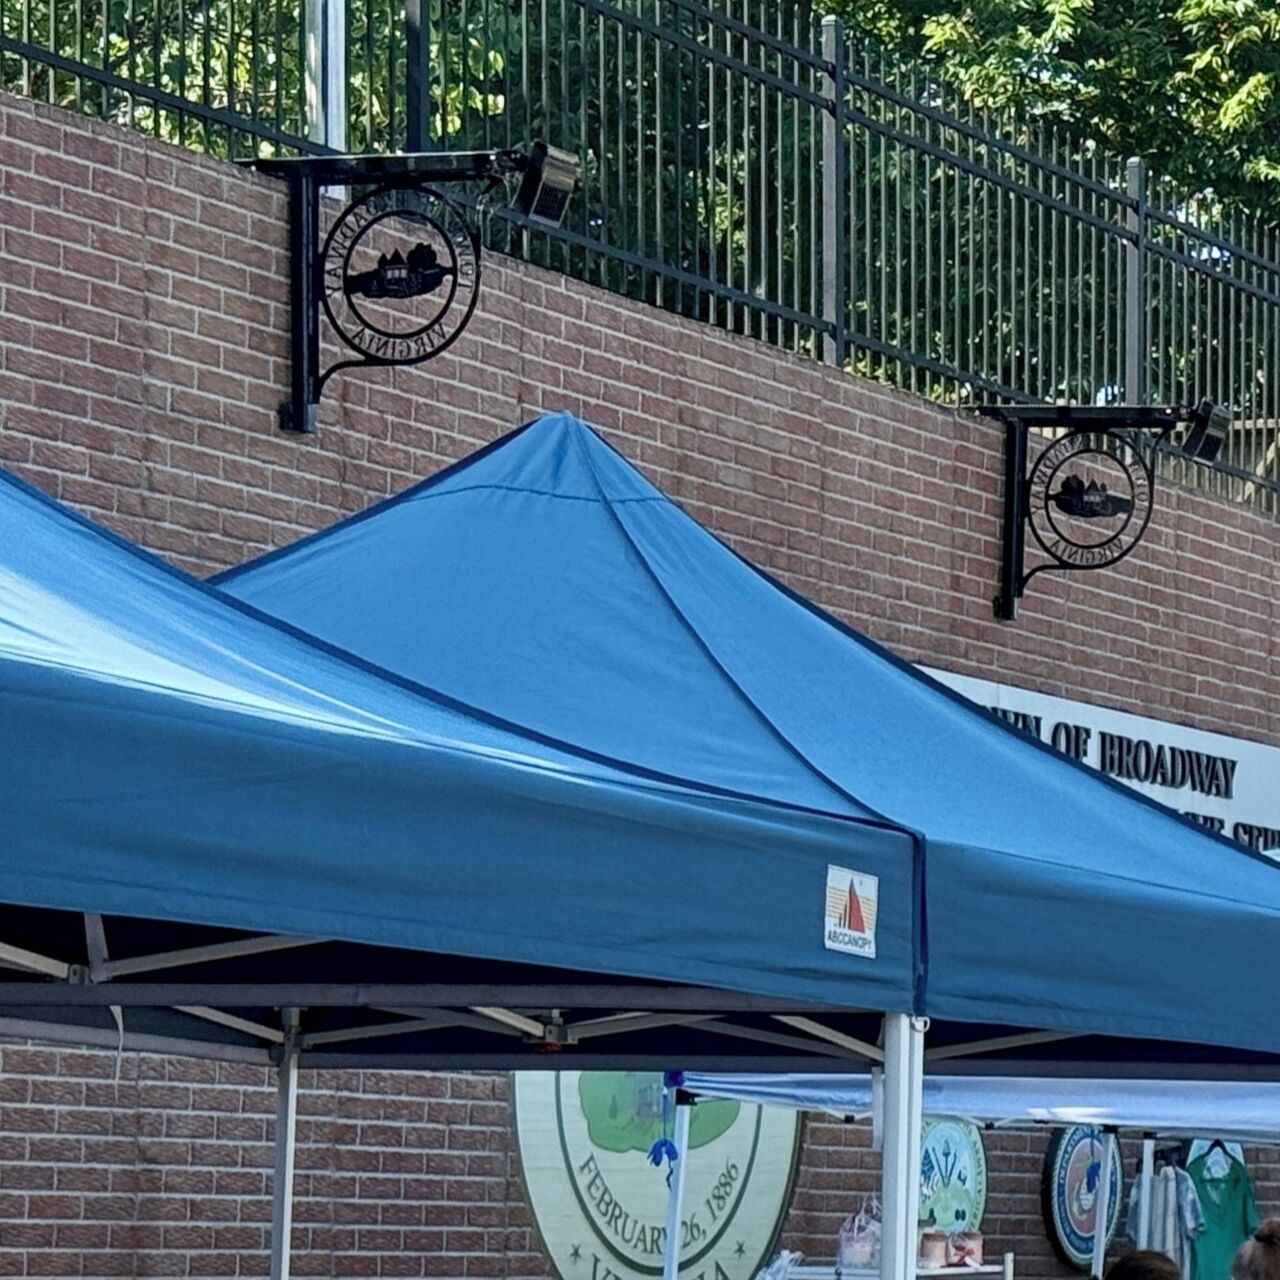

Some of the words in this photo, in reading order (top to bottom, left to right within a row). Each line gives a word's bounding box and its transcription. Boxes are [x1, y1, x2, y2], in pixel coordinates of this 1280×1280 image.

[1051, 720, 1092, 761] OF
[1099, 730, 1239, 799] BROADWAY
[681, 1212, 707, 1249] 26,
[705, 1157, 740, 1223] 1886
